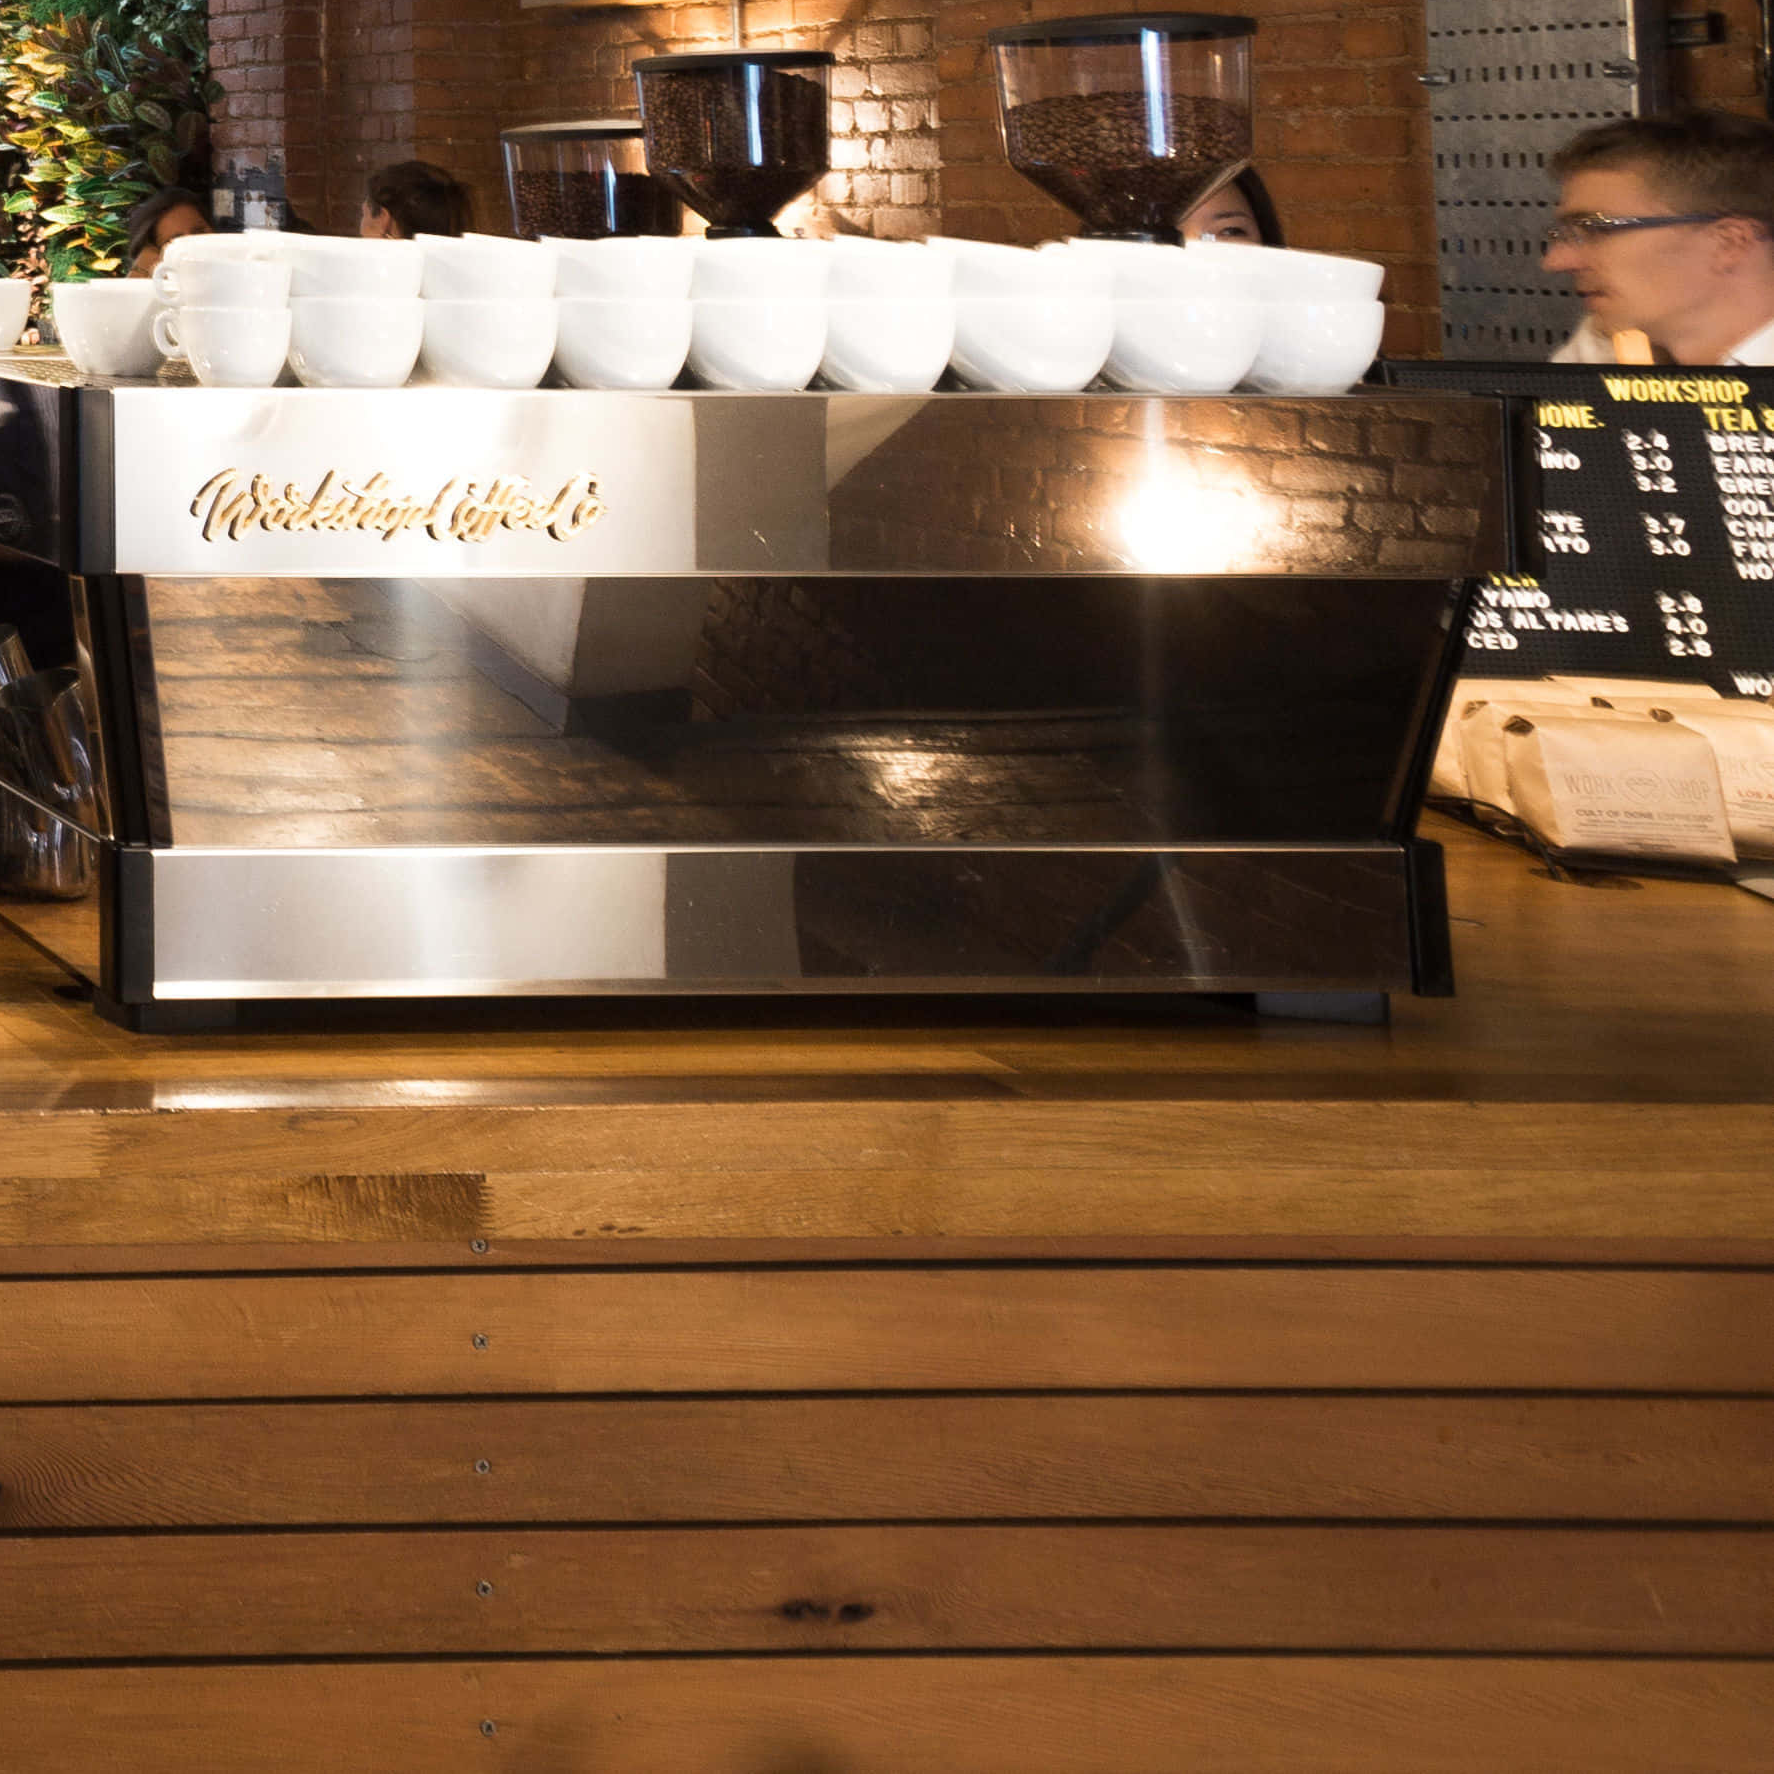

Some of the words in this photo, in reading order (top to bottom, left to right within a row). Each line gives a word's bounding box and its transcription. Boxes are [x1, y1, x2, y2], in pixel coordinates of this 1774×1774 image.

[1604, 378, 1750, 404] WORKSHOP
[1703, 408, 1759, 432] TEA
[1624, 431, 1670, 451] 2.4
[1631, 453, 1674, 472] 3.0
[1636, 475, 1679, 494] 3.2
[190, 467, 434, 543] Workshop
[424, 474, 558, 543] Coffee
[1645, 516, 1686, 536] 3.7
[1651, 538, 1692, 557] 3.0
[1477, 588, 1551, 609] YAMO
[1659, 594, 1703, 615] 2.8
[1512, 610, 1630, 633] ALTARES
[1664, 616, 1709, 636] 4.0
[1668, 638, 1713, 658] 2.8
[1564, 774, 1617, 795] WORK
